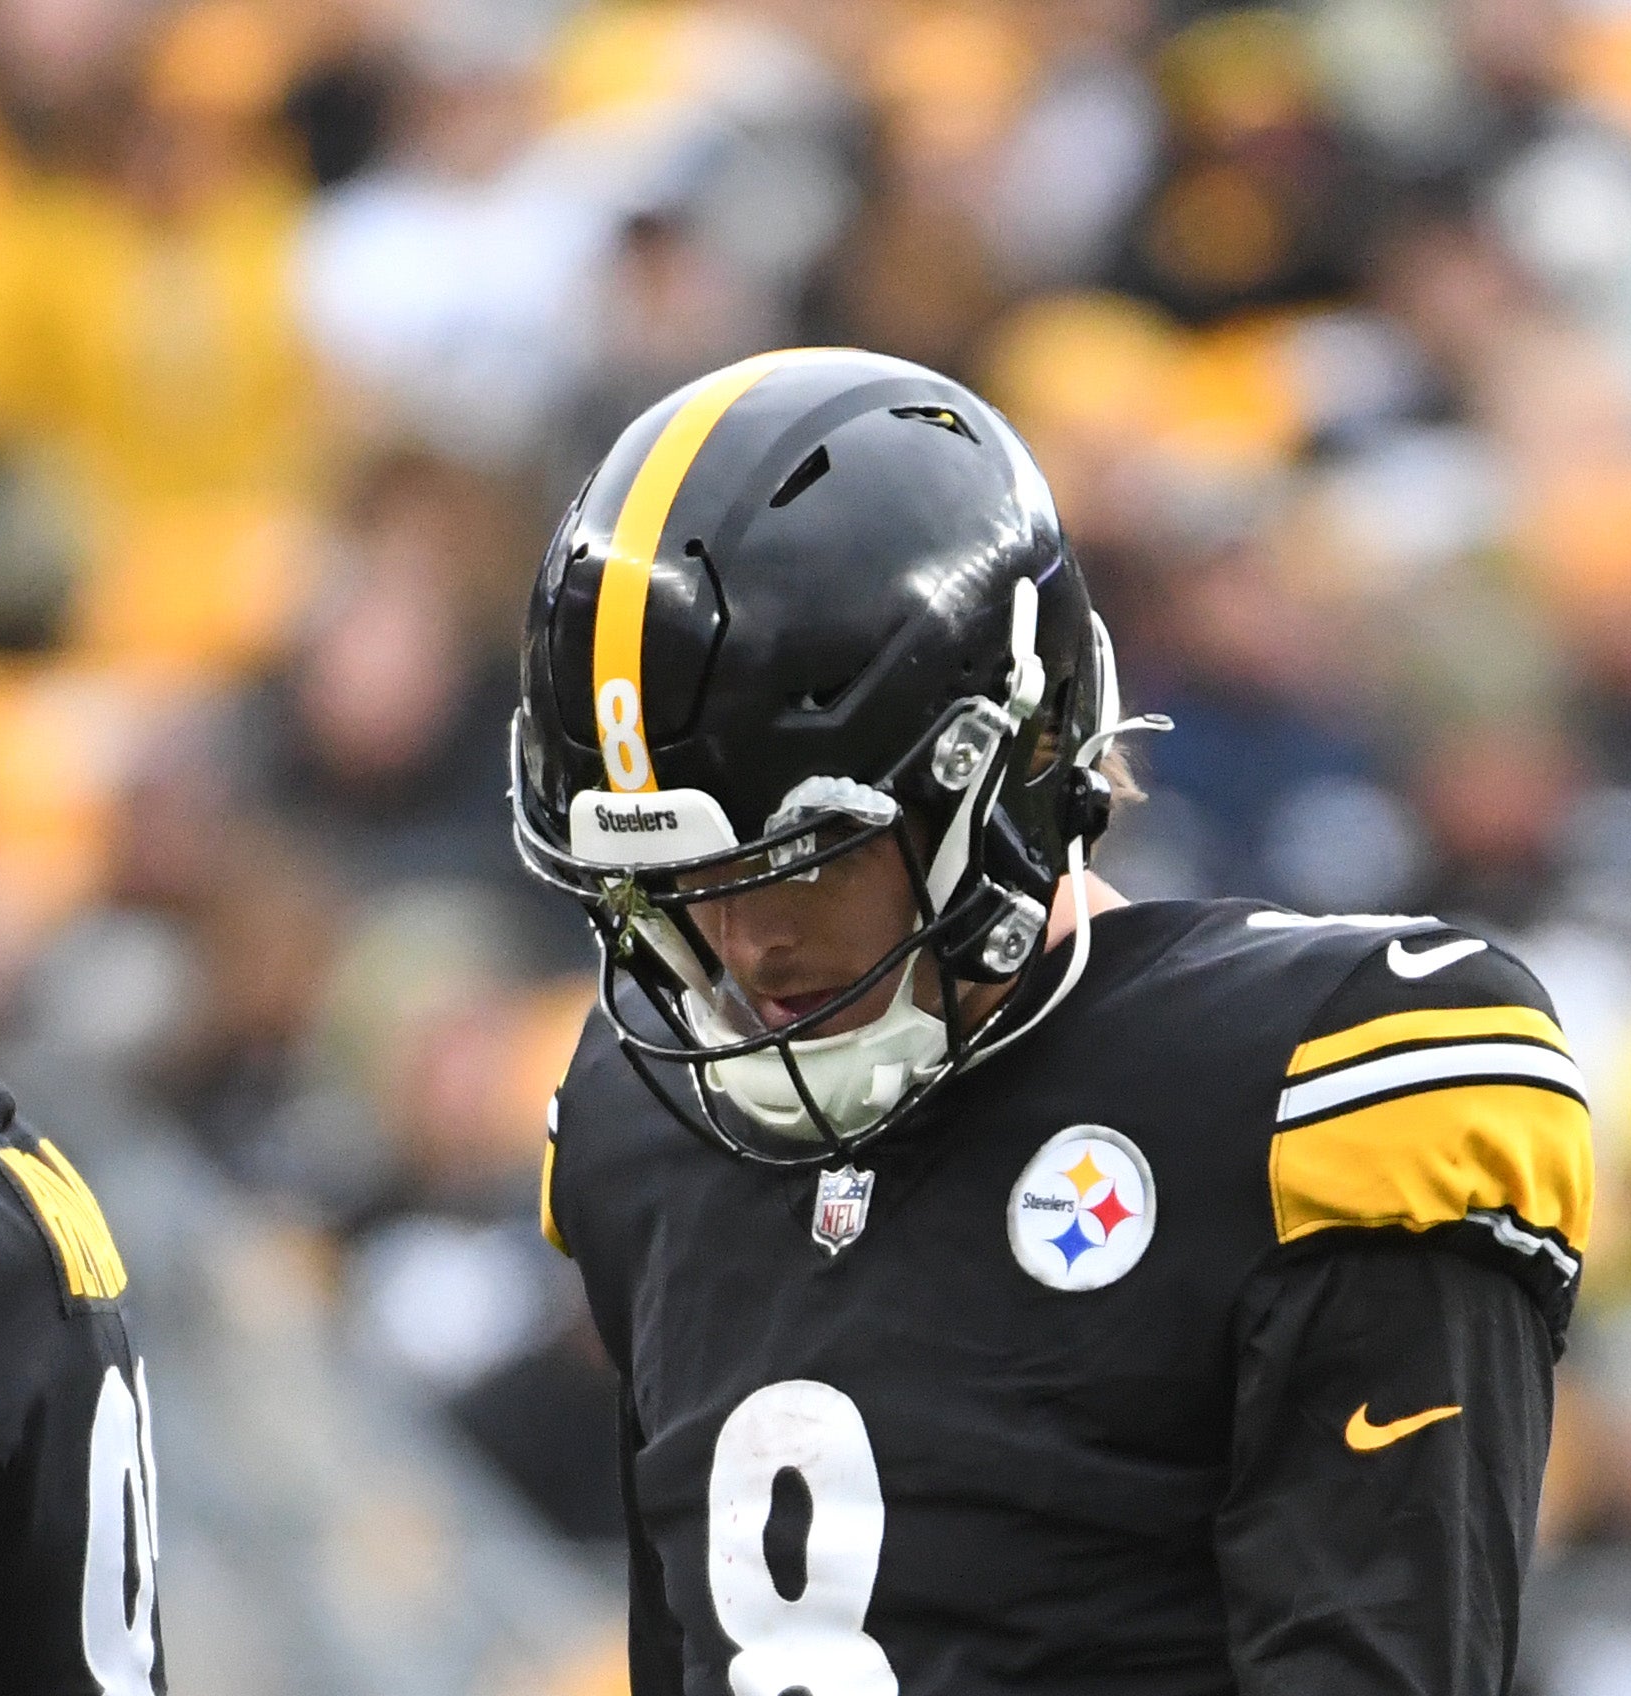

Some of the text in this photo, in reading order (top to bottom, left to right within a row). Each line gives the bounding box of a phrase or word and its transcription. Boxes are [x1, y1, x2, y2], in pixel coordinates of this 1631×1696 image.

[597, 678, 649, 791] 8
[595, 804, 678, 833] Steelers
[1022, 1191, 1075, 1213] Steelers
[821, 1203, 855, 1237] NFL
